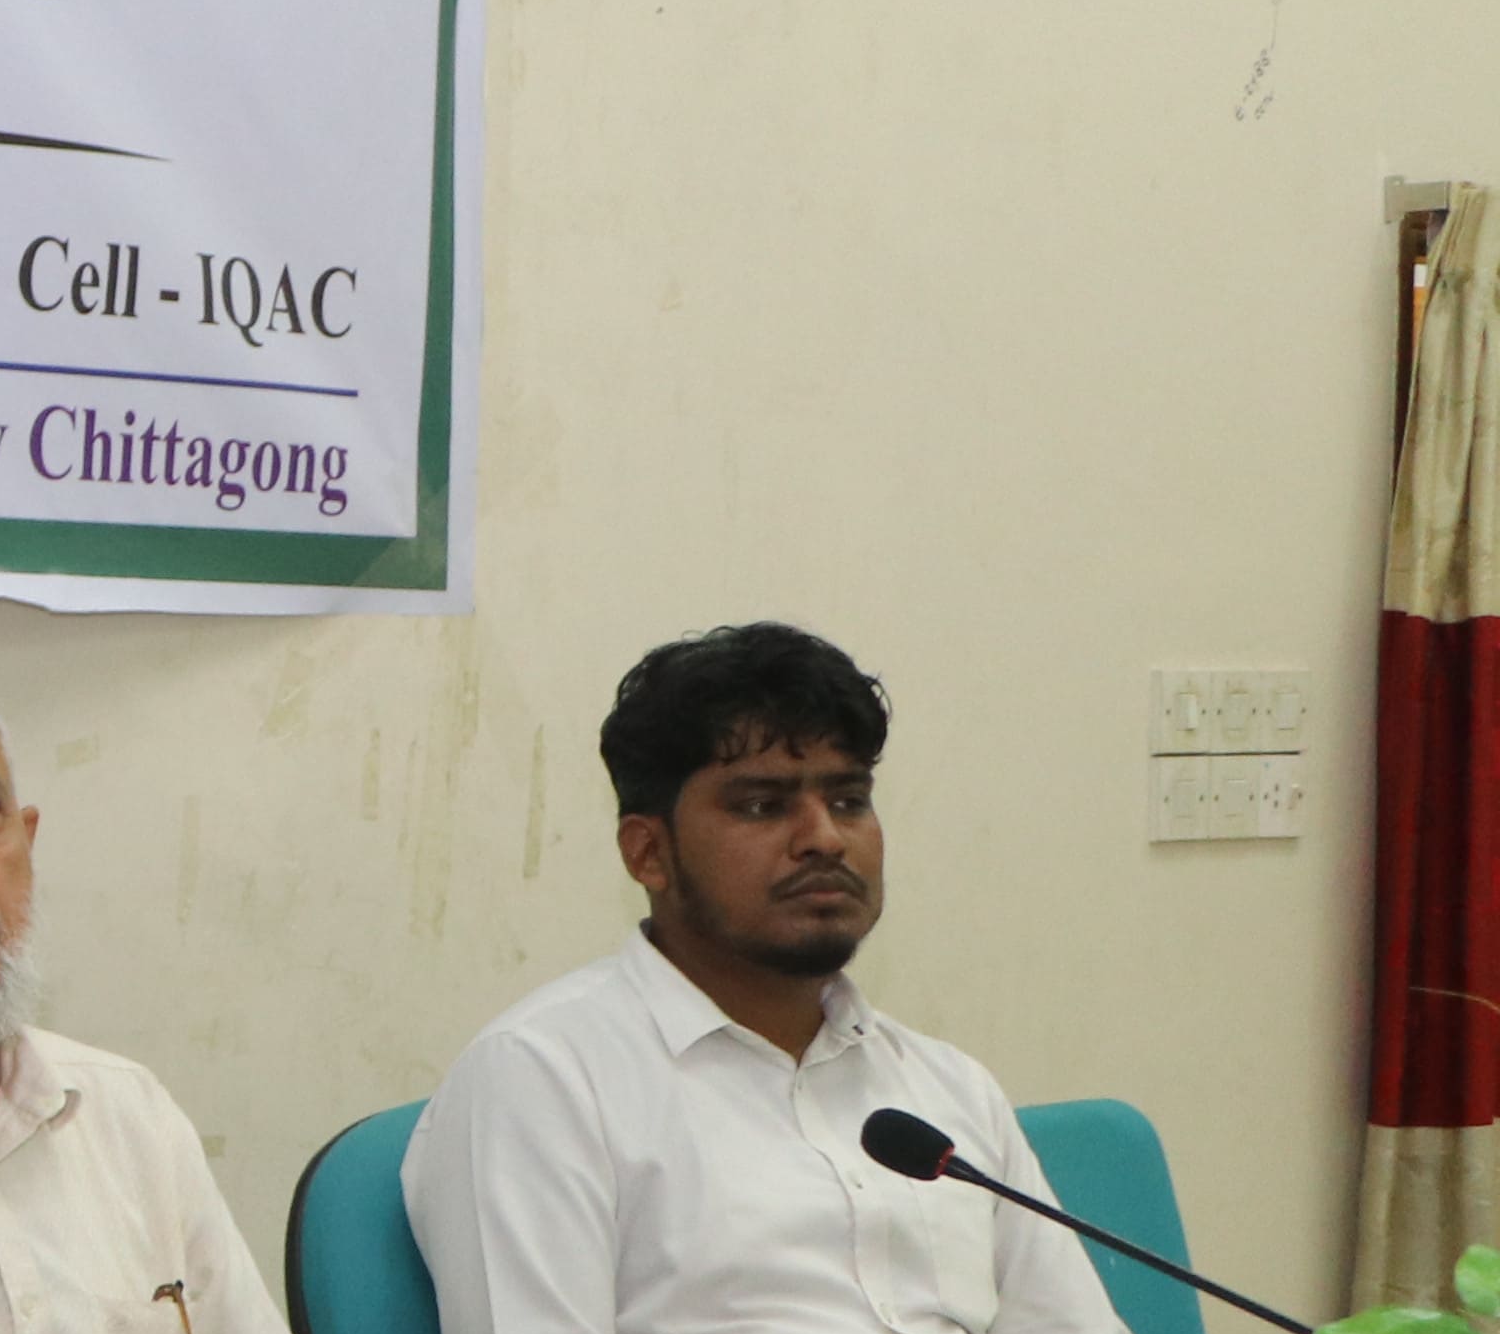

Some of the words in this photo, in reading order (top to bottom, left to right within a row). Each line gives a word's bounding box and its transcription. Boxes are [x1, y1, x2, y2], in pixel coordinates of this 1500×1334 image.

[15, 231, 140, 320] Cell
[197, 252, 358, 350] IQAC
[27, 403, 349, 513] Chittagong
